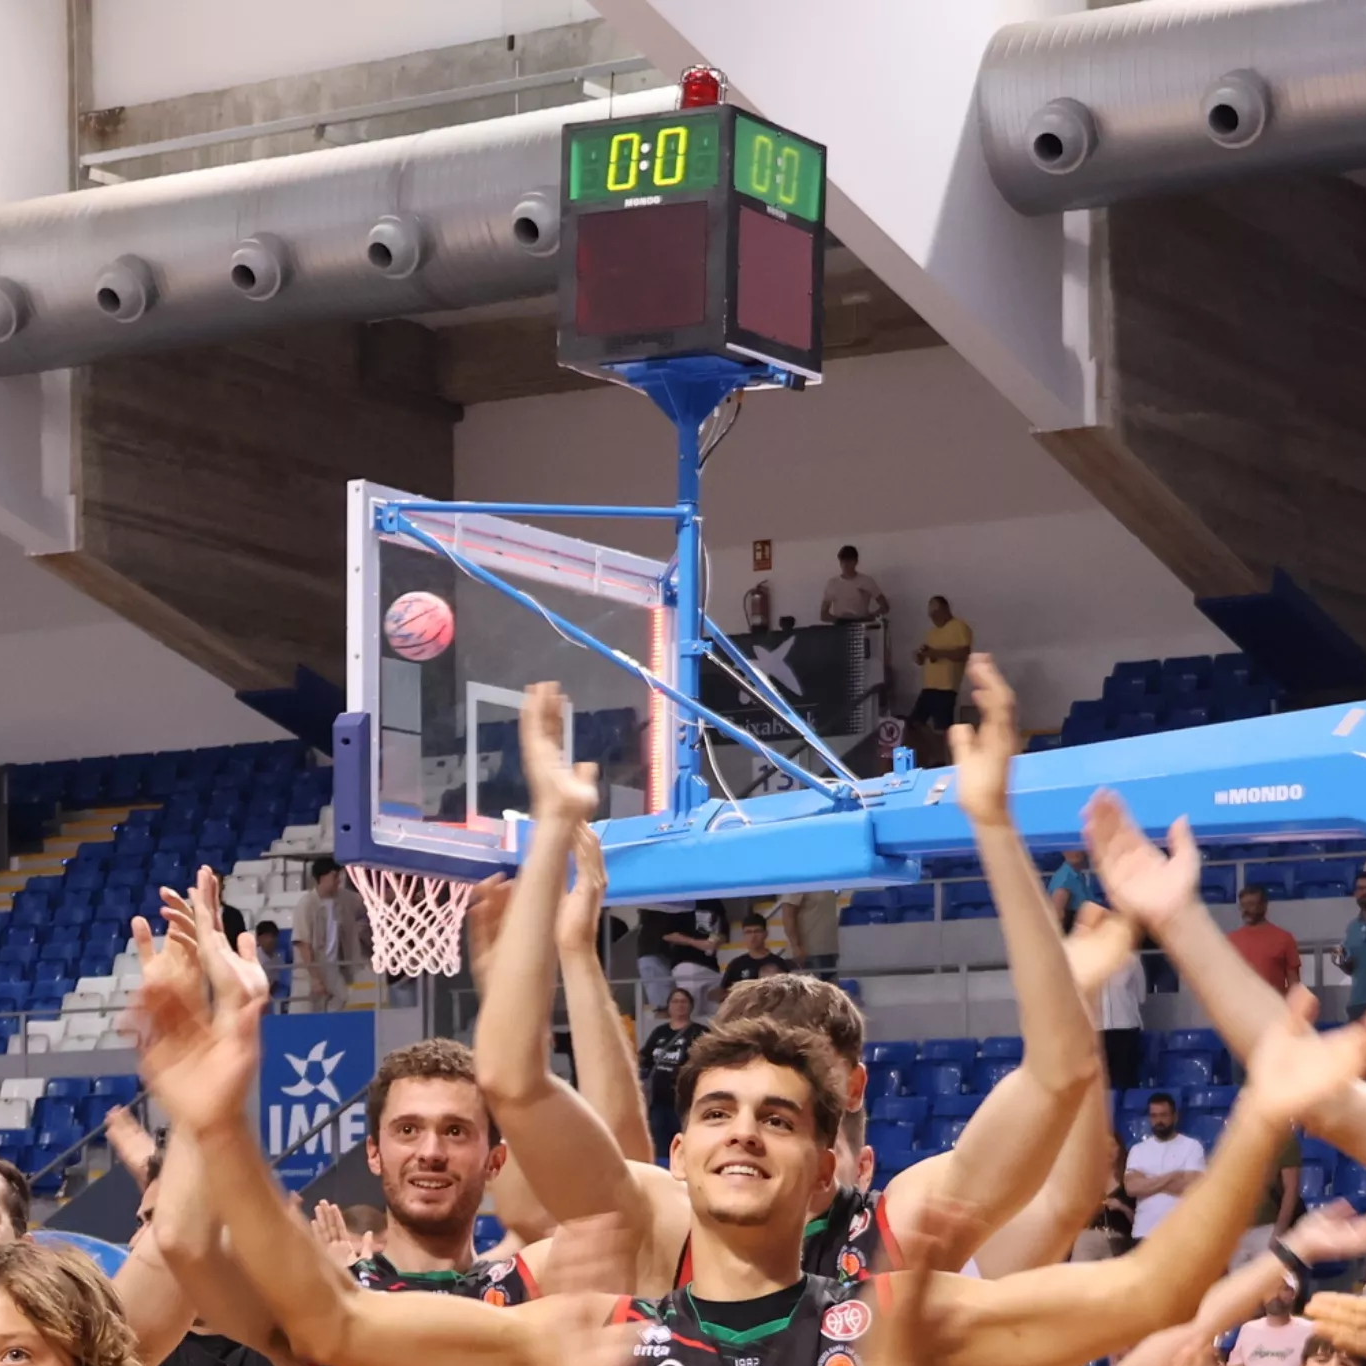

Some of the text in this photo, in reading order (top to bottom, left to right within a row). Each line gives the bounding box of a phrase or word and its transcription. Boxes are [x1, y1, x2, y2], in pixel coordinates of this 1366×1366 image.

[624, 195, 661, 208] MONDO
[1228, 784, 1303, 805] MONDO
[269, 1103, 366, 1156] IME
